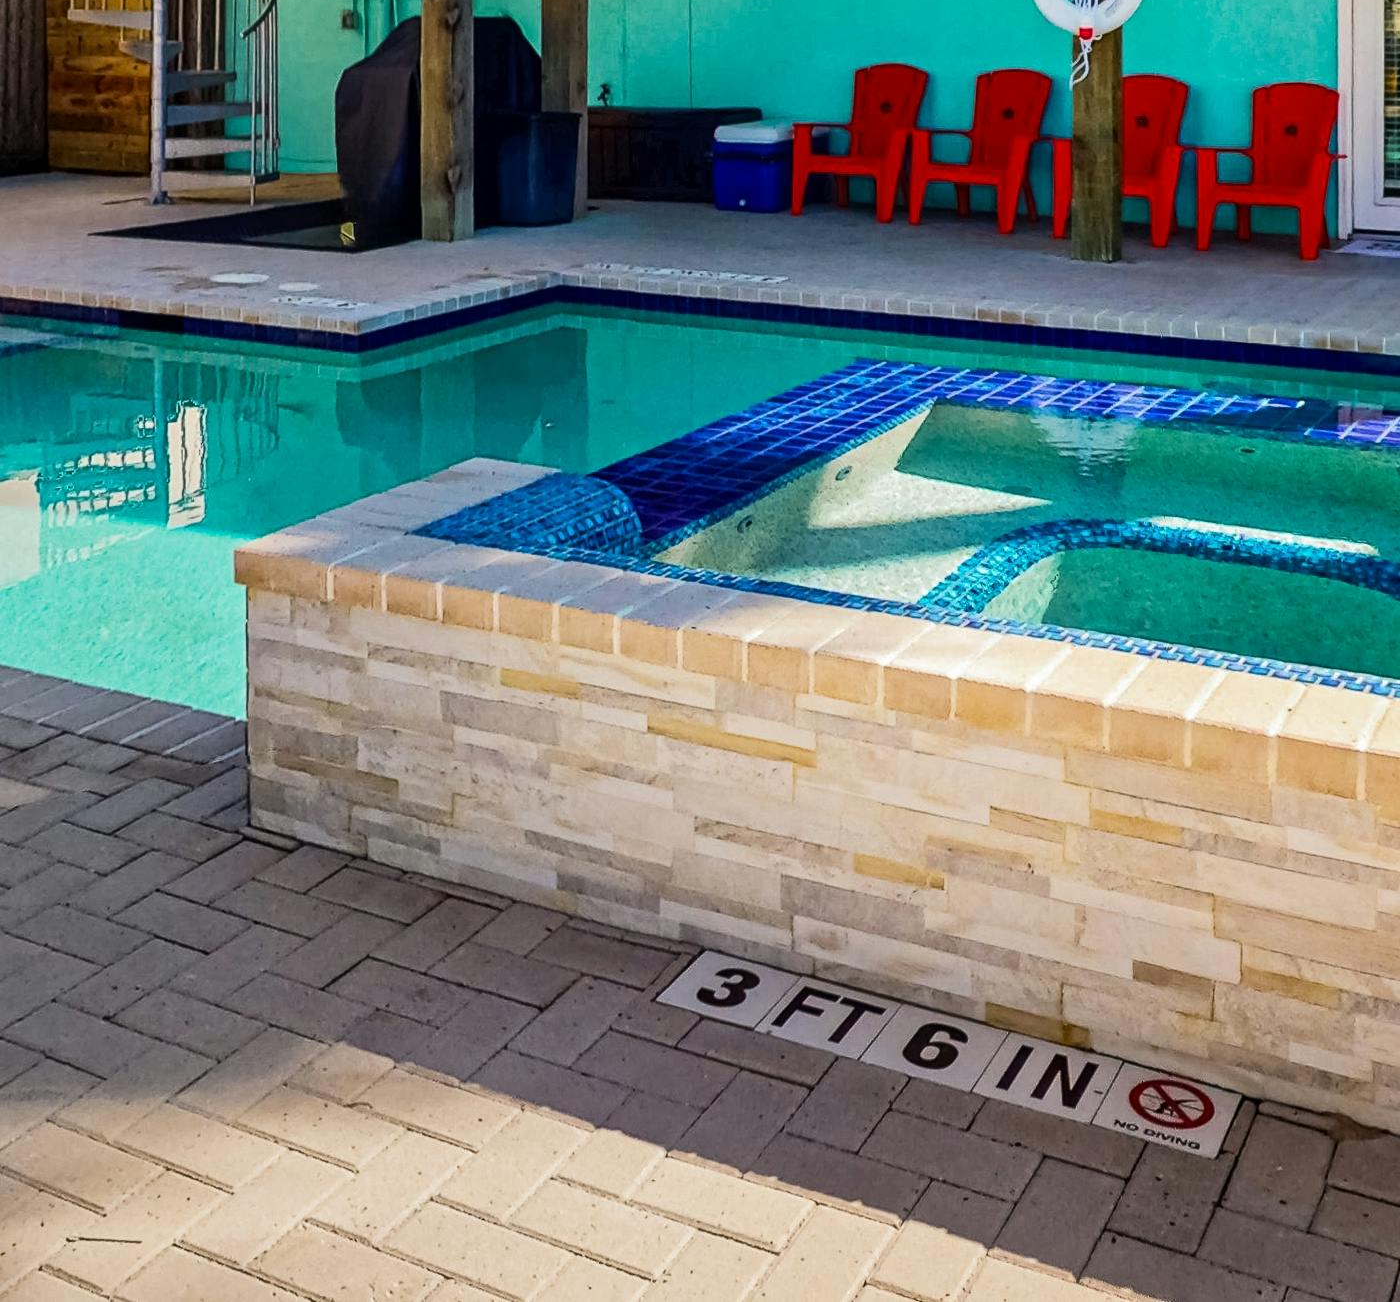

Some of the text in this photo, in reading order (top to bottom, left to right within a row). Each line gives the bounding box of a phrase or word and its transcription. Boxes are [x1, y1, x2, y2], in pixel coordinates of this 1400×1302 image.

[696, 967, 1100, 1110] 3 FT 6 IN
[1113, 1119, 1201, 1150] NO DIVING
